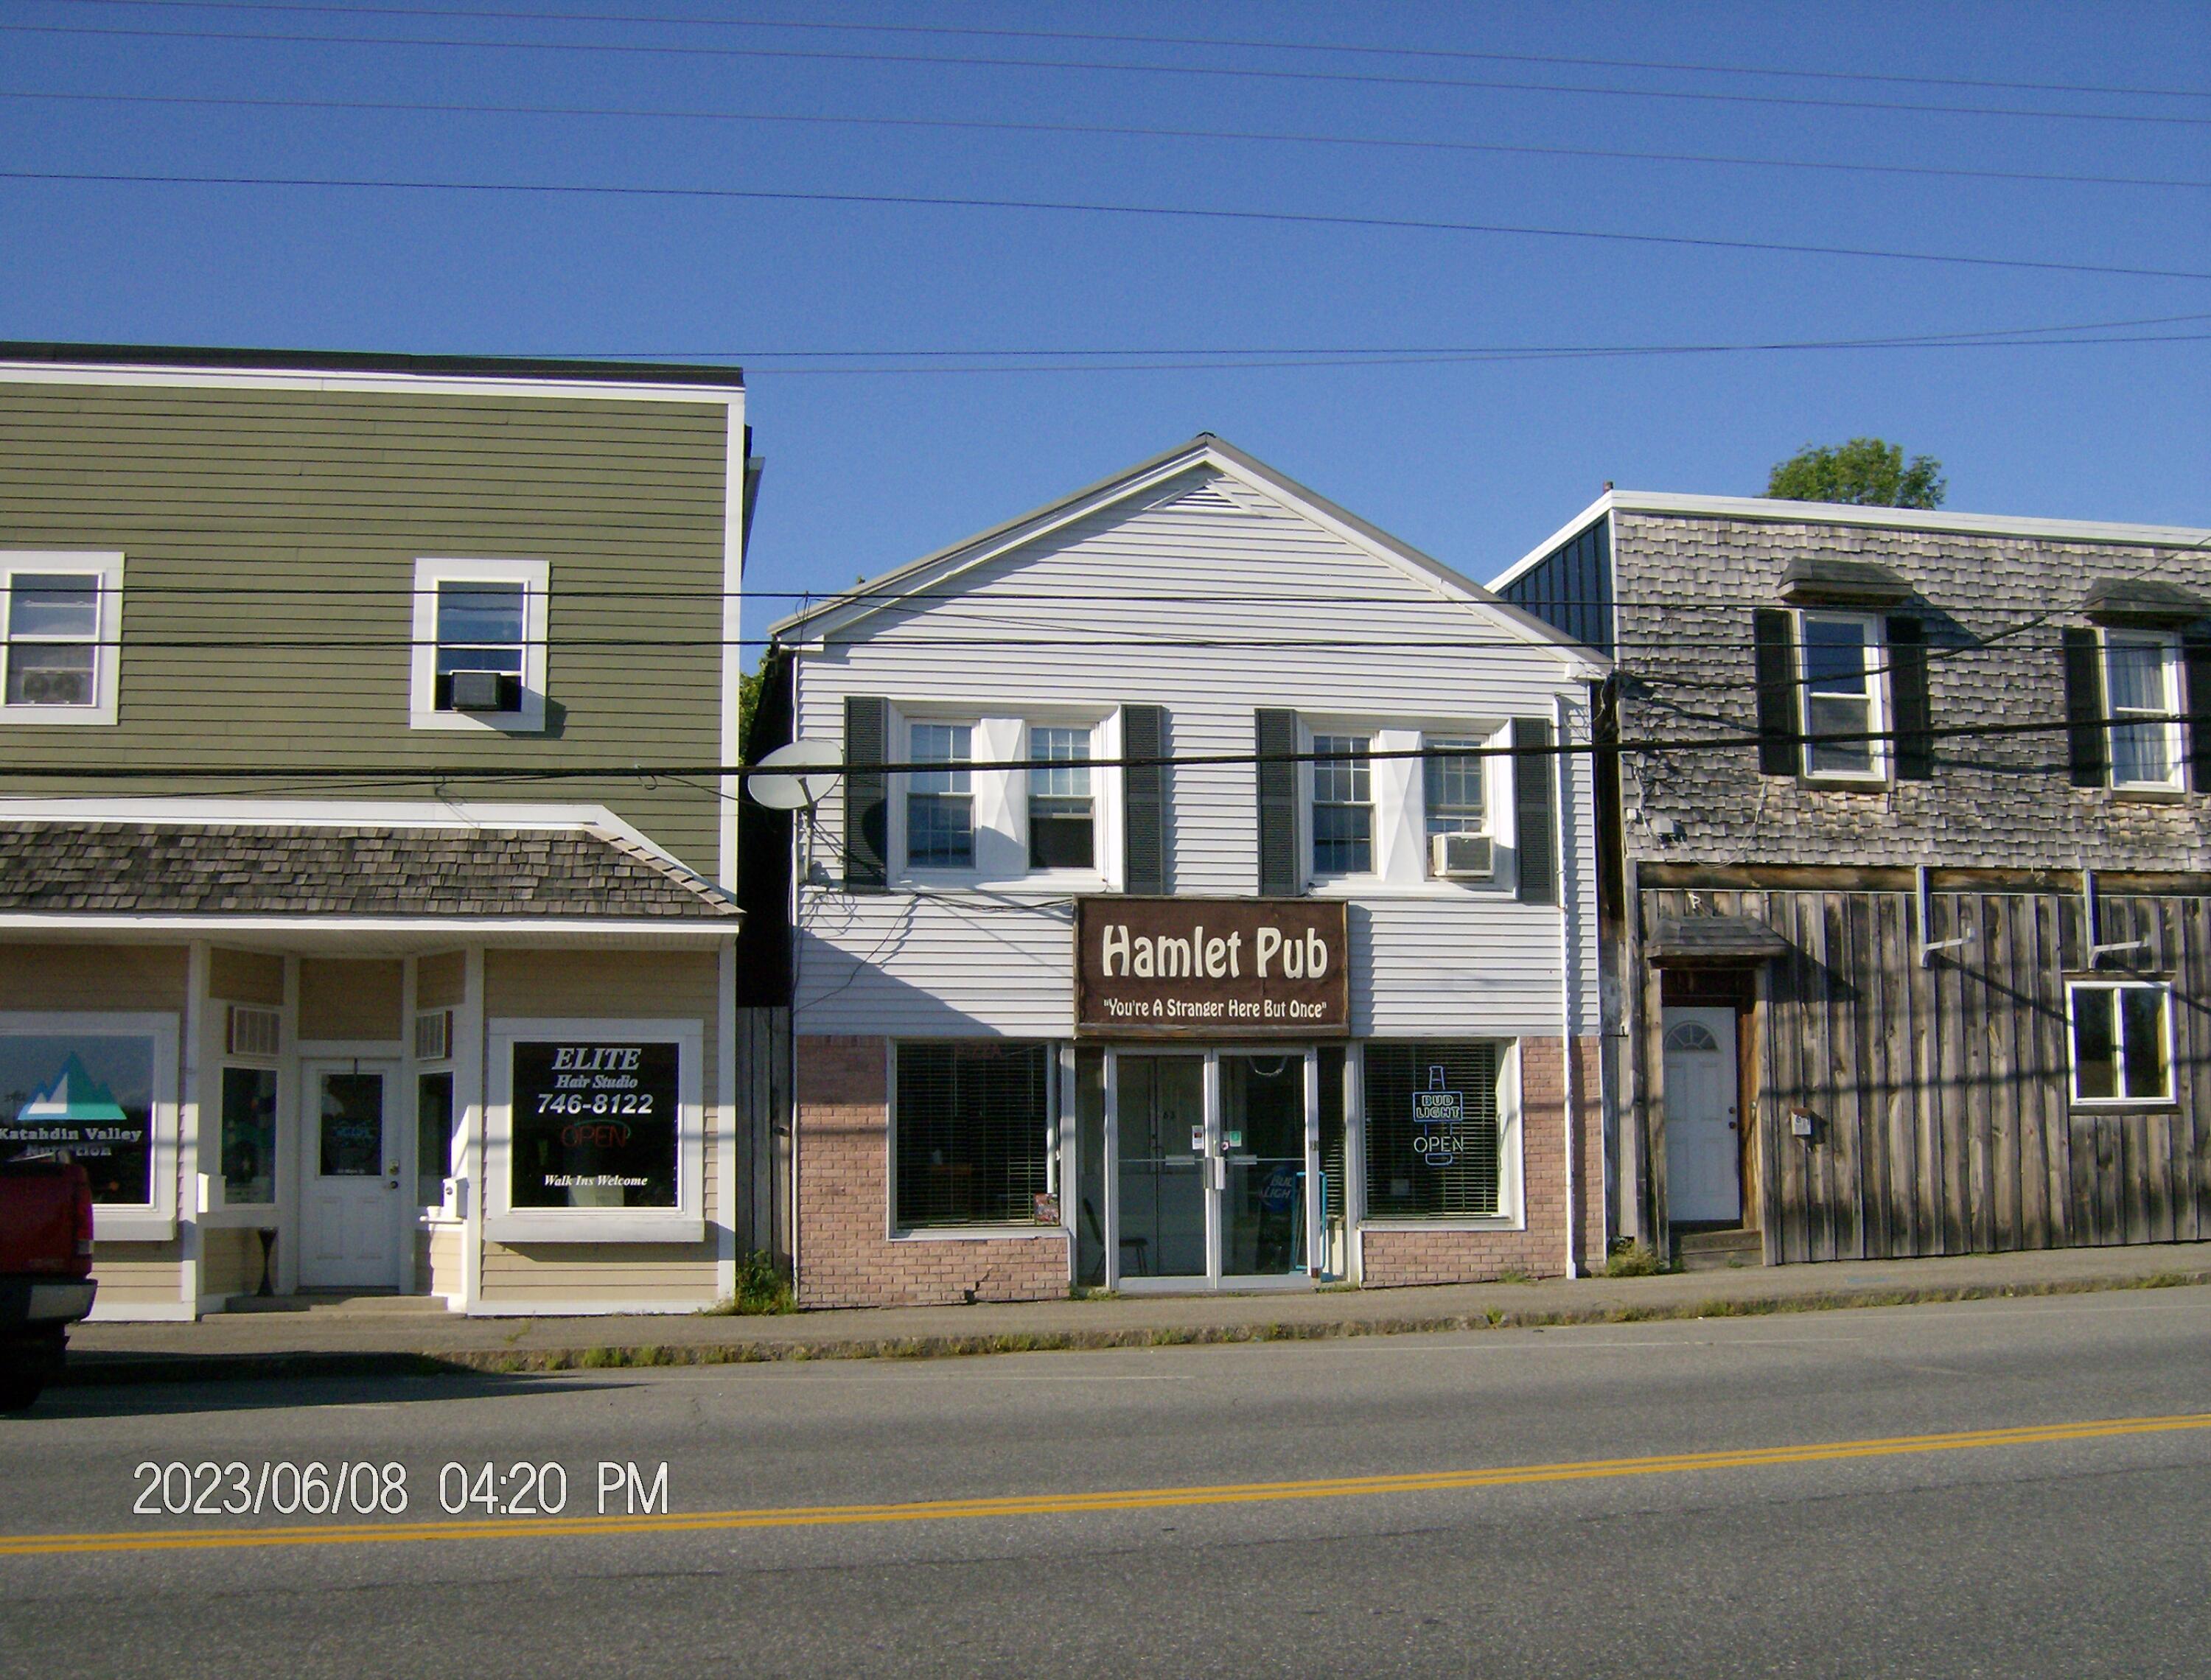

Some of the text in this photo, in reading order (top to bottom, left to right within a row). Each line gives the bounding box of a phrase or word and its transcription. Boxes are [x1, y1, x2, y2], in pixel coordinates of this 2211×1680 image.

[1103, 925, 1327, 979] Hamlet Pub
[1153, 999, 1163, 1017] A
[1167, 998, 1224, 1018] Stranger
[1228, 999, 1260, 1018] Here
[1264, 999, 1286, 1018] But
[1290, 999, 1327, 1018] Once"
[551, 1047, 641, 1071] ELITE
[555, 1074, 638, 1088] Hair Studio
[538, 1093, 654, 1114] 746-8122
[1422, 1095, 1453, 1107] BUD
[1416, 1107, 1460, 1119] LIGHT
[0, 1127, 142, 1142] Katahdin Valley
[560, 1124, 626, 1148] OPEN
[1414, 1136, 1464, 1152] OPEN
[545, 1175, 648, 1186] Walk Ins Welcome
[1262, 1186, 1291, 1199] LIGH
